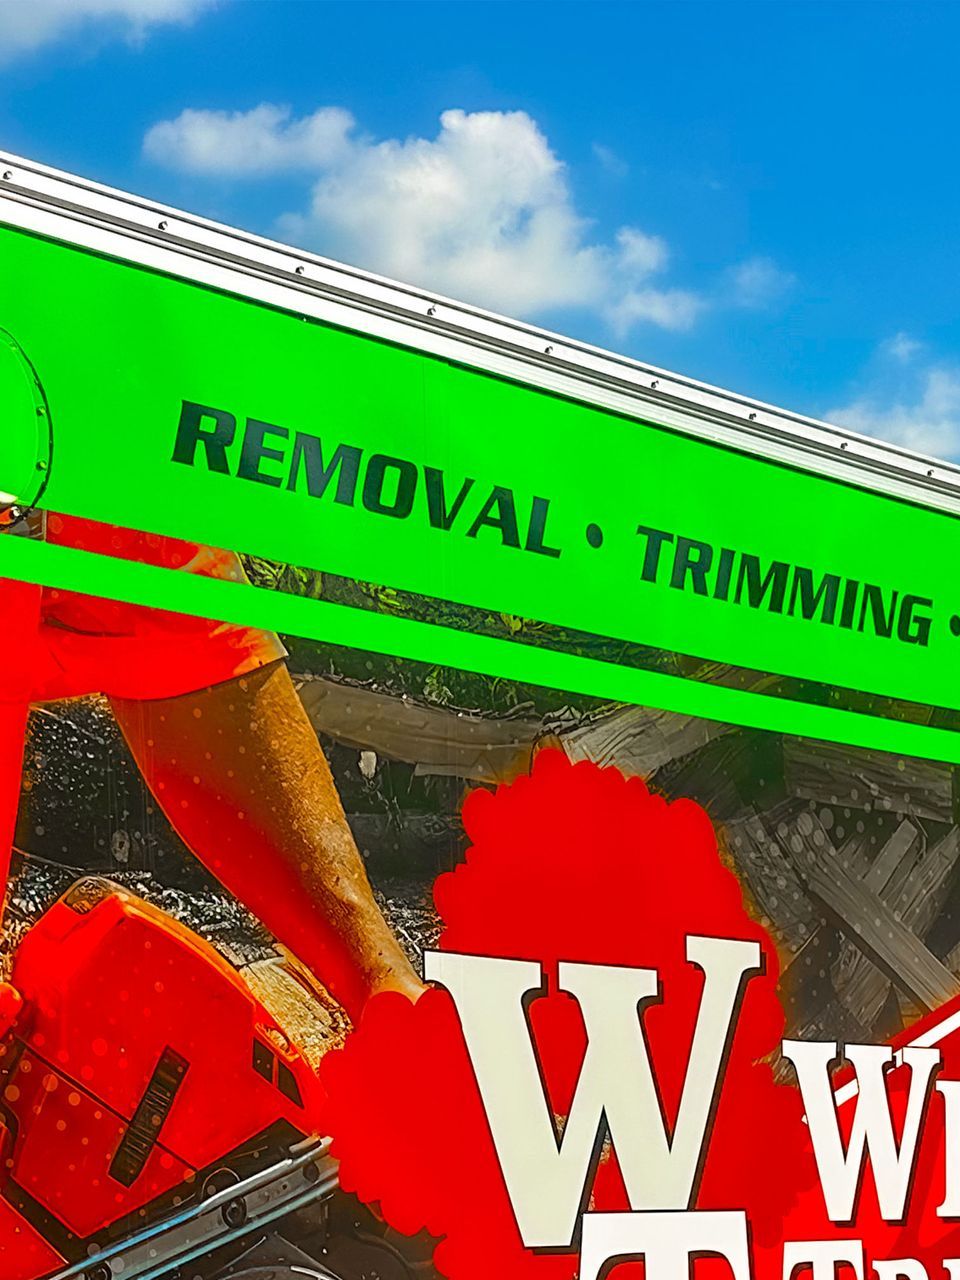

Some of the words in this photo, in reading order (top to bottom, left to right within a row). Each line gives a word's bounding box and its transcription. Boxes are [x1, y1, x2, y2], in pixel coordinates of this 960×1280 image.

[171, 400, 562, 560] REMOVAL
[635, 525, 935, 647] TRIMMING
[424, 934, 766, 1250] W
